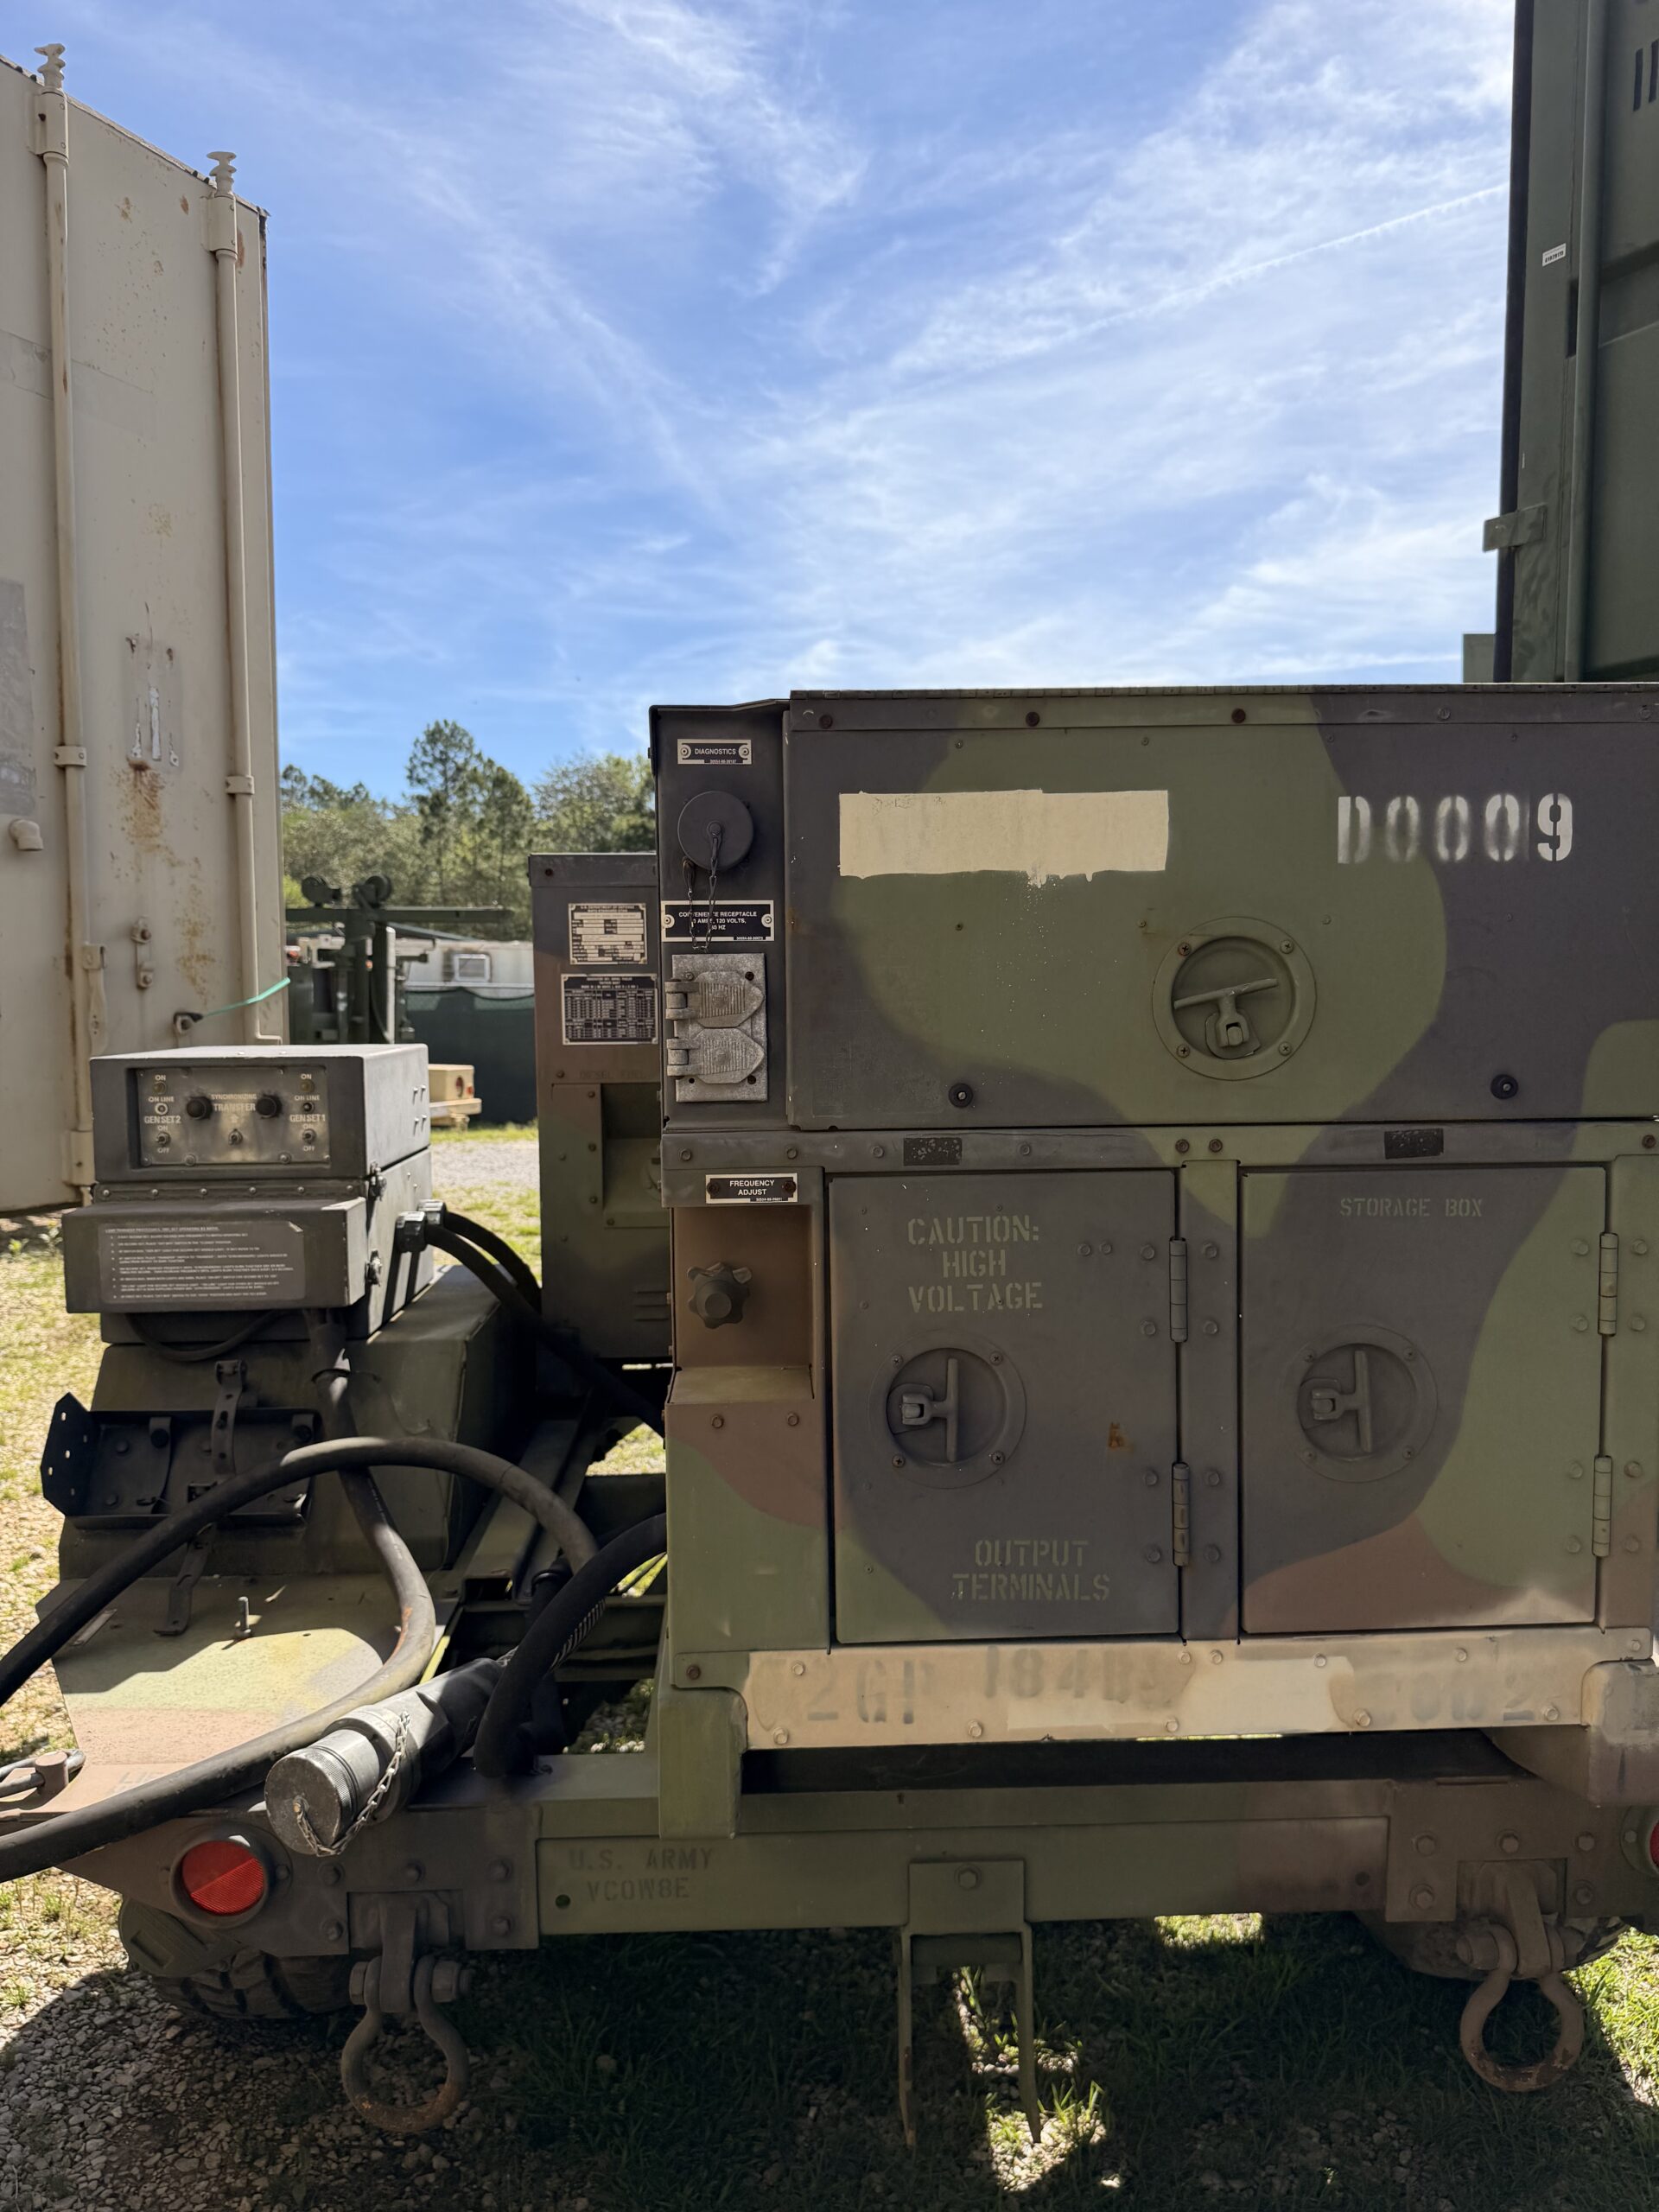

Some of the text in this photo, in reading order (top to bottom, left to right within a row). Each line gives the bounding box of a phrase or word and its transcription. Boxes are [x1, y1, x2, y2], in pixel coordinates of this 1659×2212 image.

[213, 1103, 256, 1112] TRANSFER
[289, 1114, 307, 1122] GEN
[307, 1114, 321, 1122] SET
[1339, 1198, 1483, 1217] STORAGE BOX
[907, 1215, 1039, 1245] CAUTION:
[942, 1249, 1006, 1278] HIGH
[908, 1282, 1043, 1313] VOLTAGE
[975, 1540, 1089, 1567] OUTPUT
[952, 1573, 1110, 1600] TERMINALS
[569, 1847, 713, 1872] U.S. ARMY
